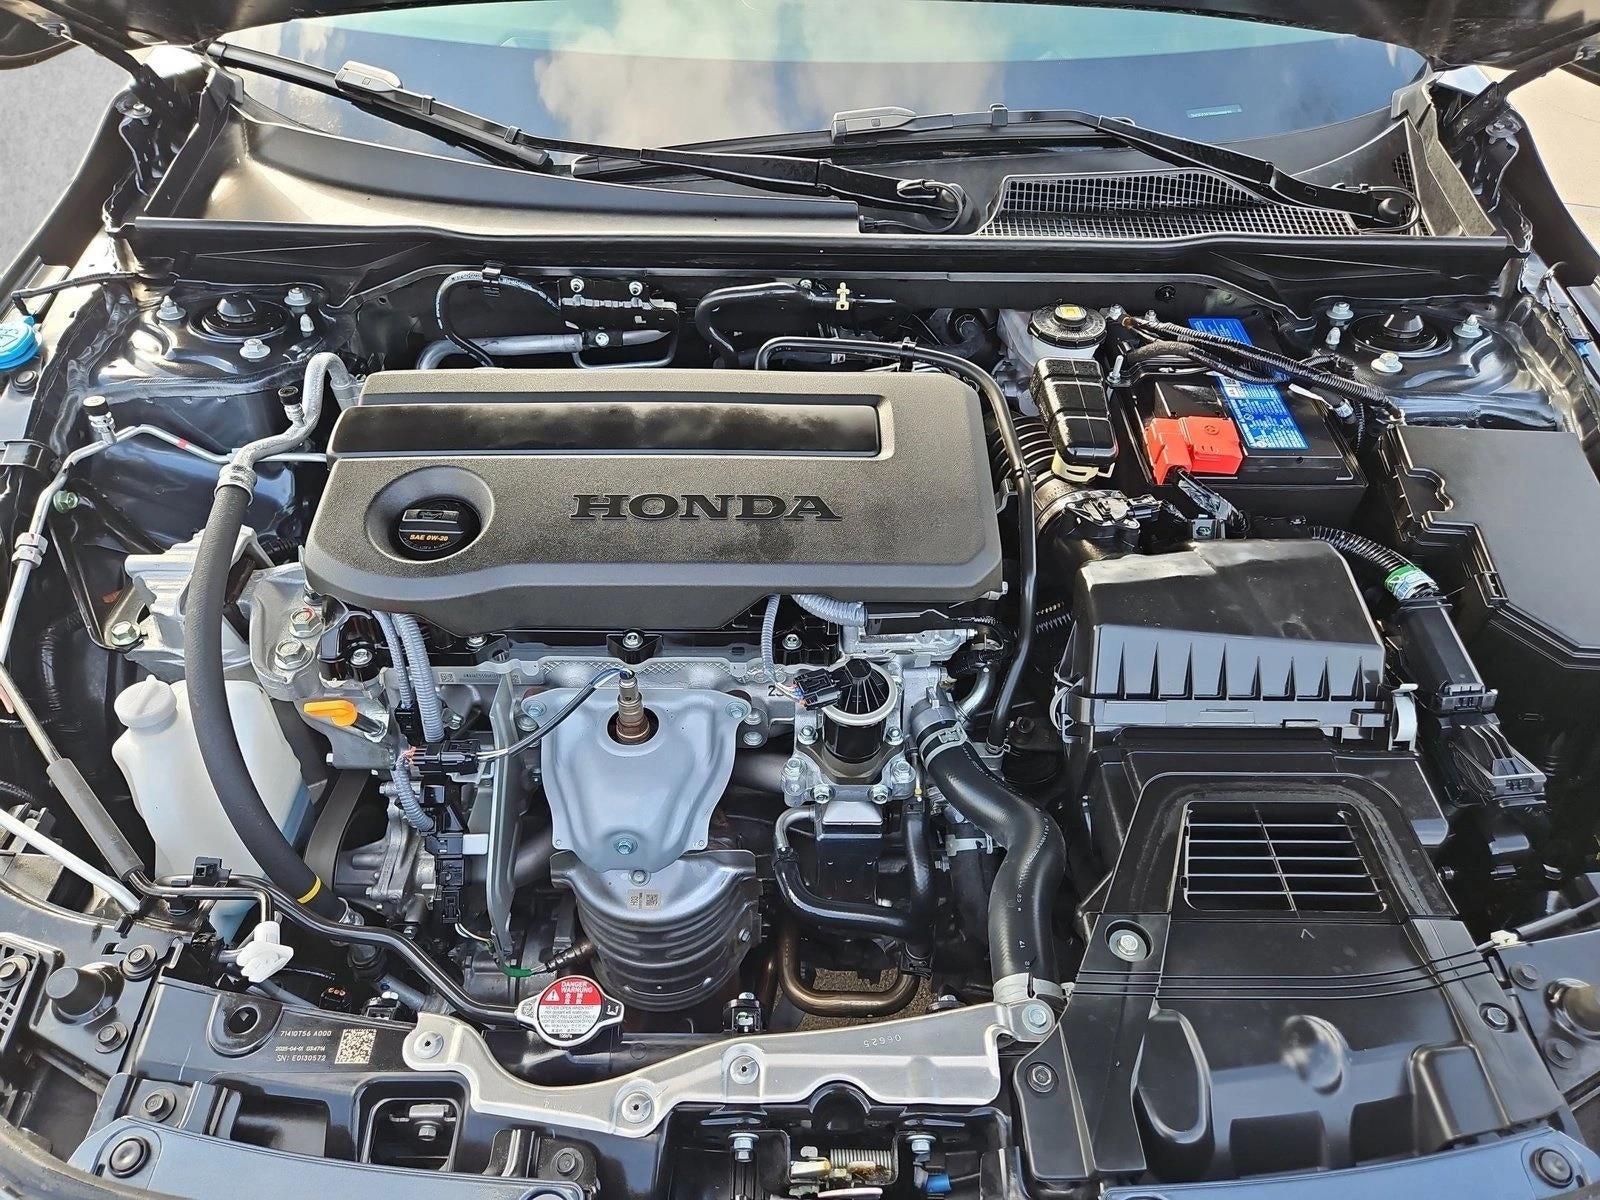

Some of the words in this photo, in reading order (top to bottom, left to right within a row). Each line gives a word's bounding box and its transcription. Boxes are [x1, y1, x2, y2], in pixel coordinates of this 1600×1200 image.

[570, 493, 843, 521] HONDA
[276, 1054, 290, 1062] SN:
[291, 1054, 327, 1062] E0130572
